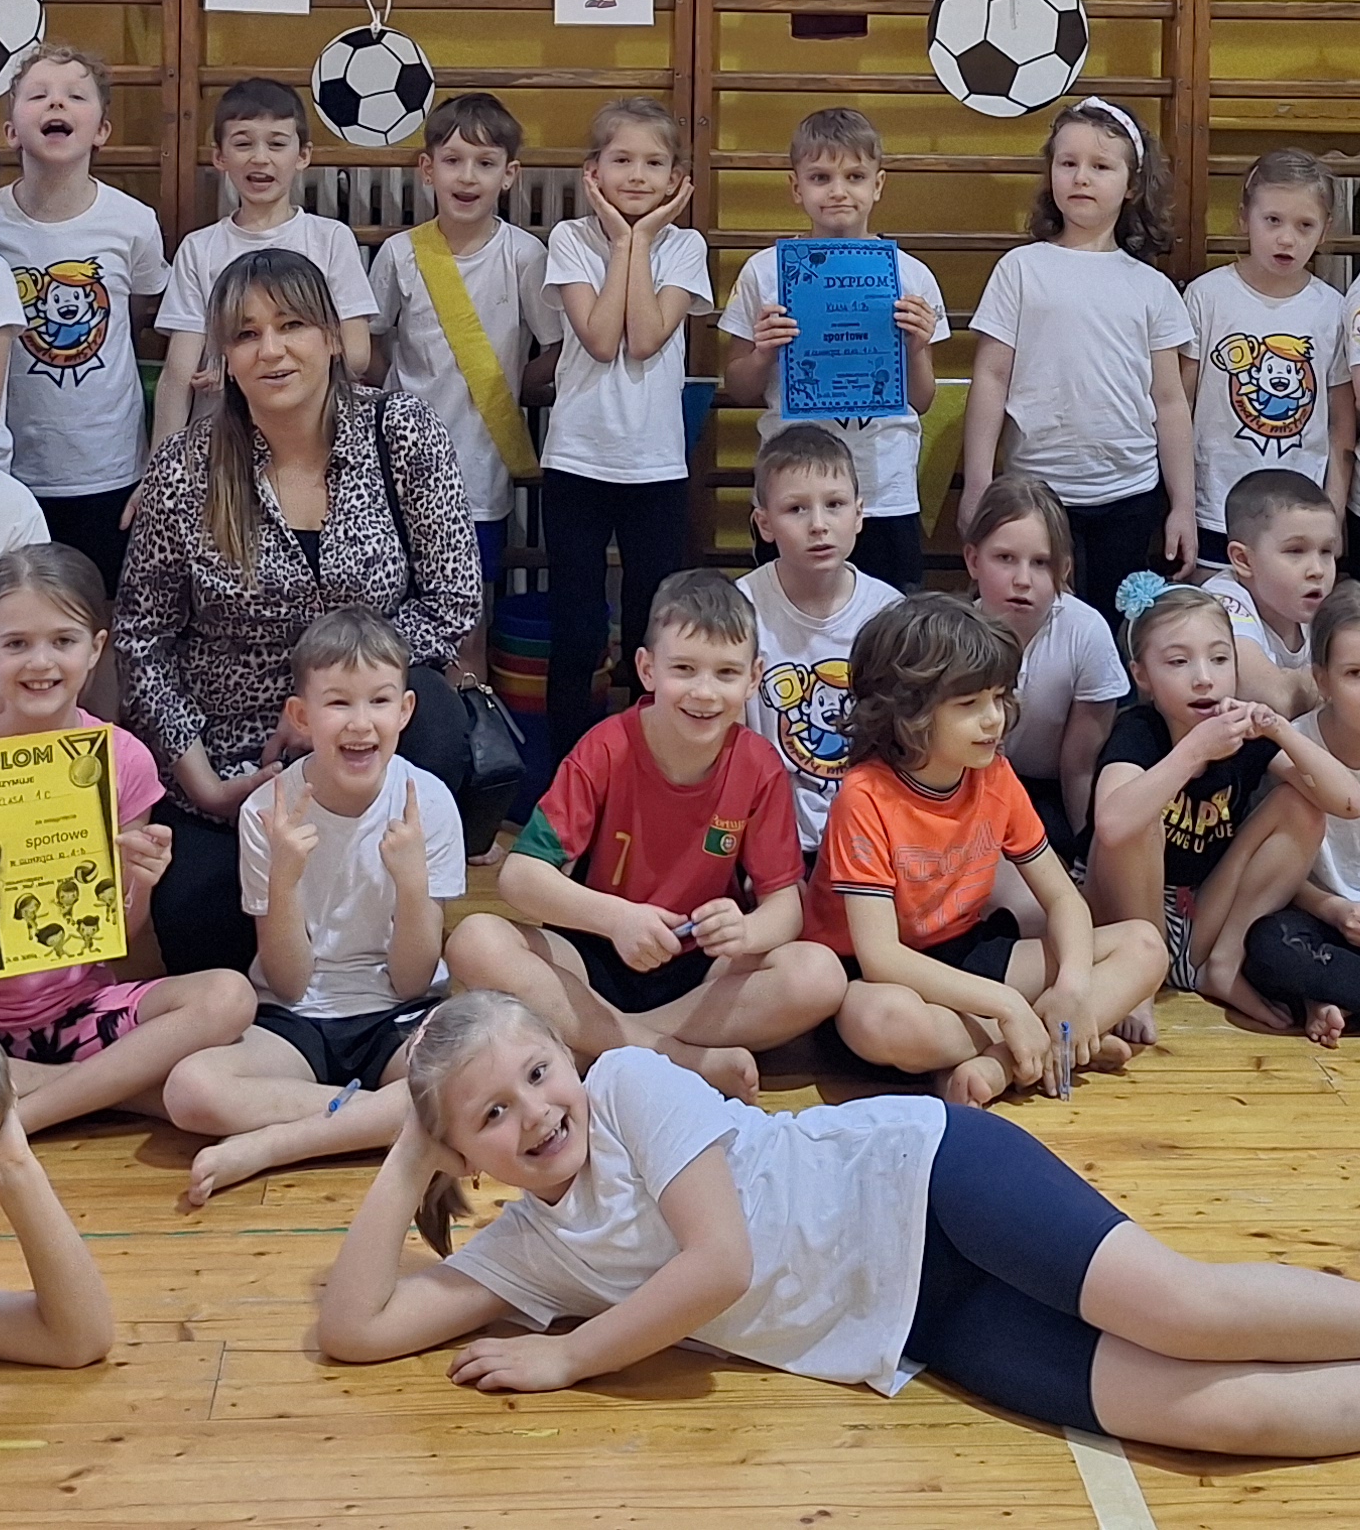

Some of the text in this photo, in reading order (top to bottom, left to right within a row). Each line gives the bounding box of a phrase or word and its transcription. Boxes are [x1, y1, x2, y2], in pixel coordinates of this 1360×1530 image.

[824, 275, 890, 289] DYPLOM
[823, 330, 869, 344] sportowe
[25, 826, 90, 851] sportowe
[611, 830, 632, 887] 7
